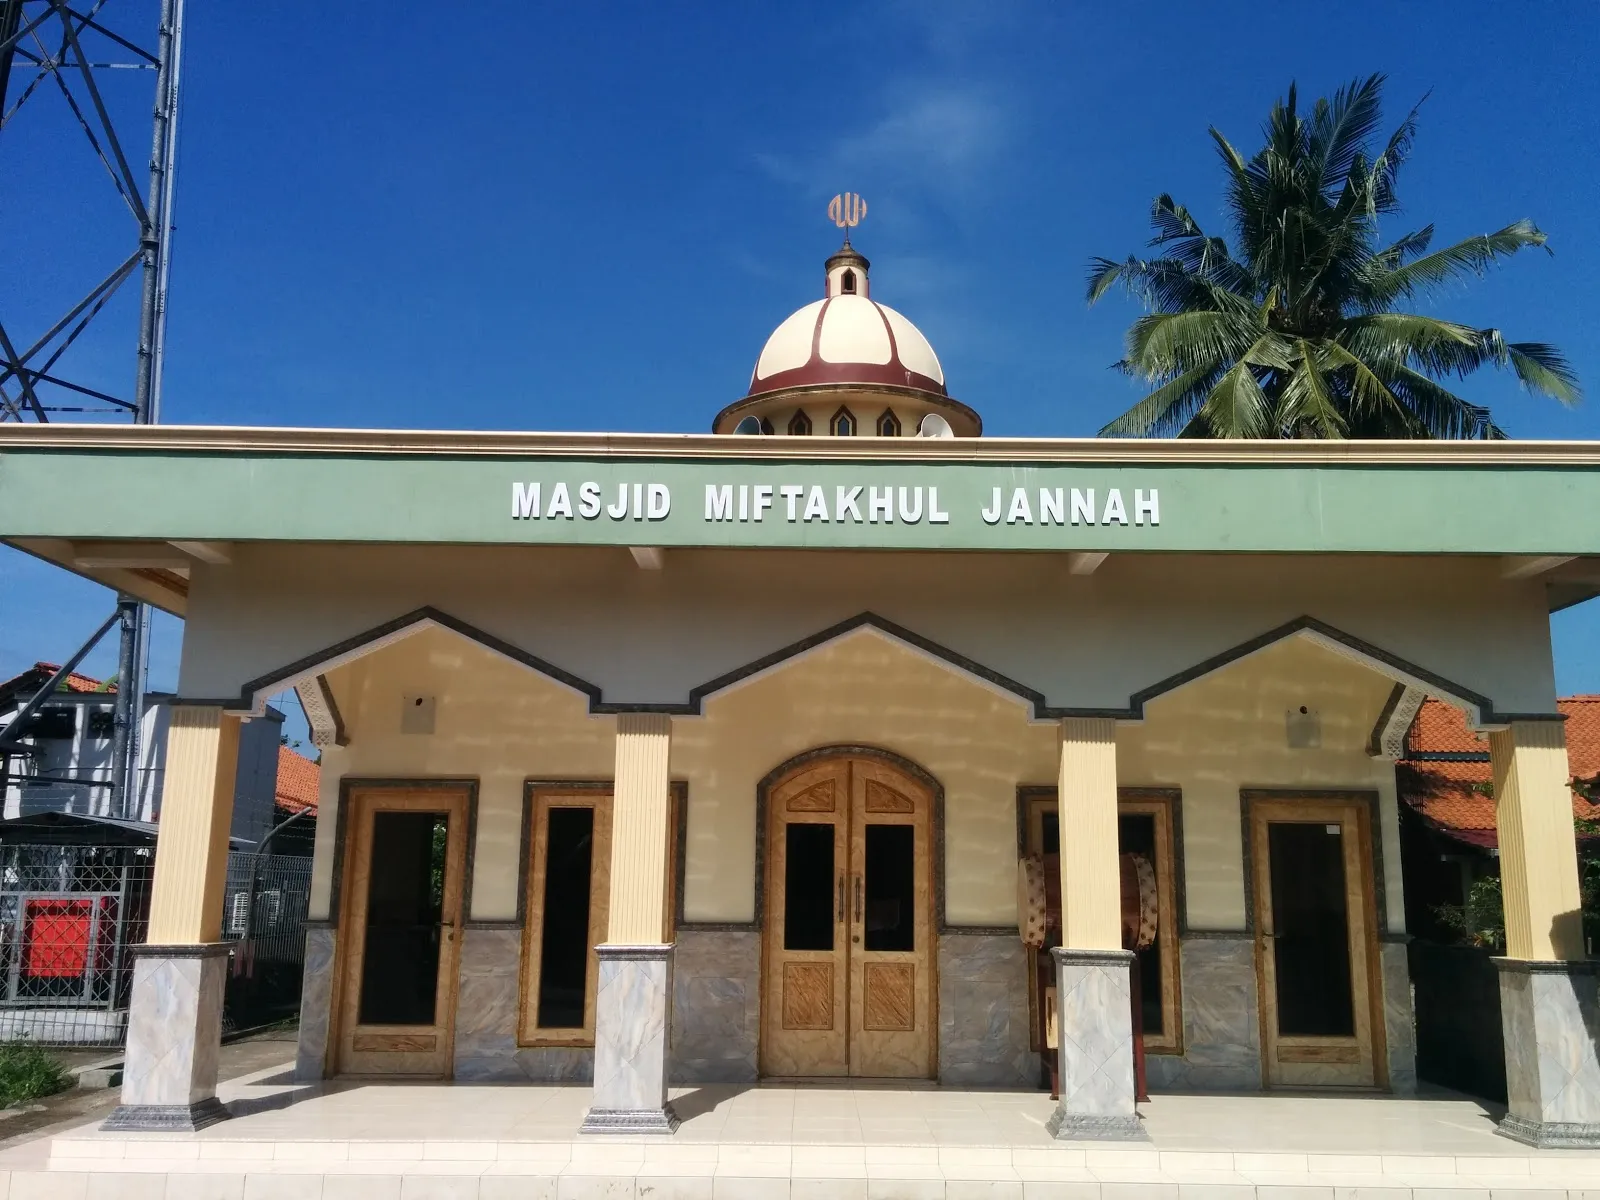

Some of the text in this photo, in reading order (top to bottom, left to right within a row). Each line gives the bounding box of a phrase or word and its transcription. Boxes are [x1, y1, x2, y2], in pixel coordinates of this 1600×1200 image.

[511, 481, 1161, 526] MASJID MIFTAKHUL JANNAH
